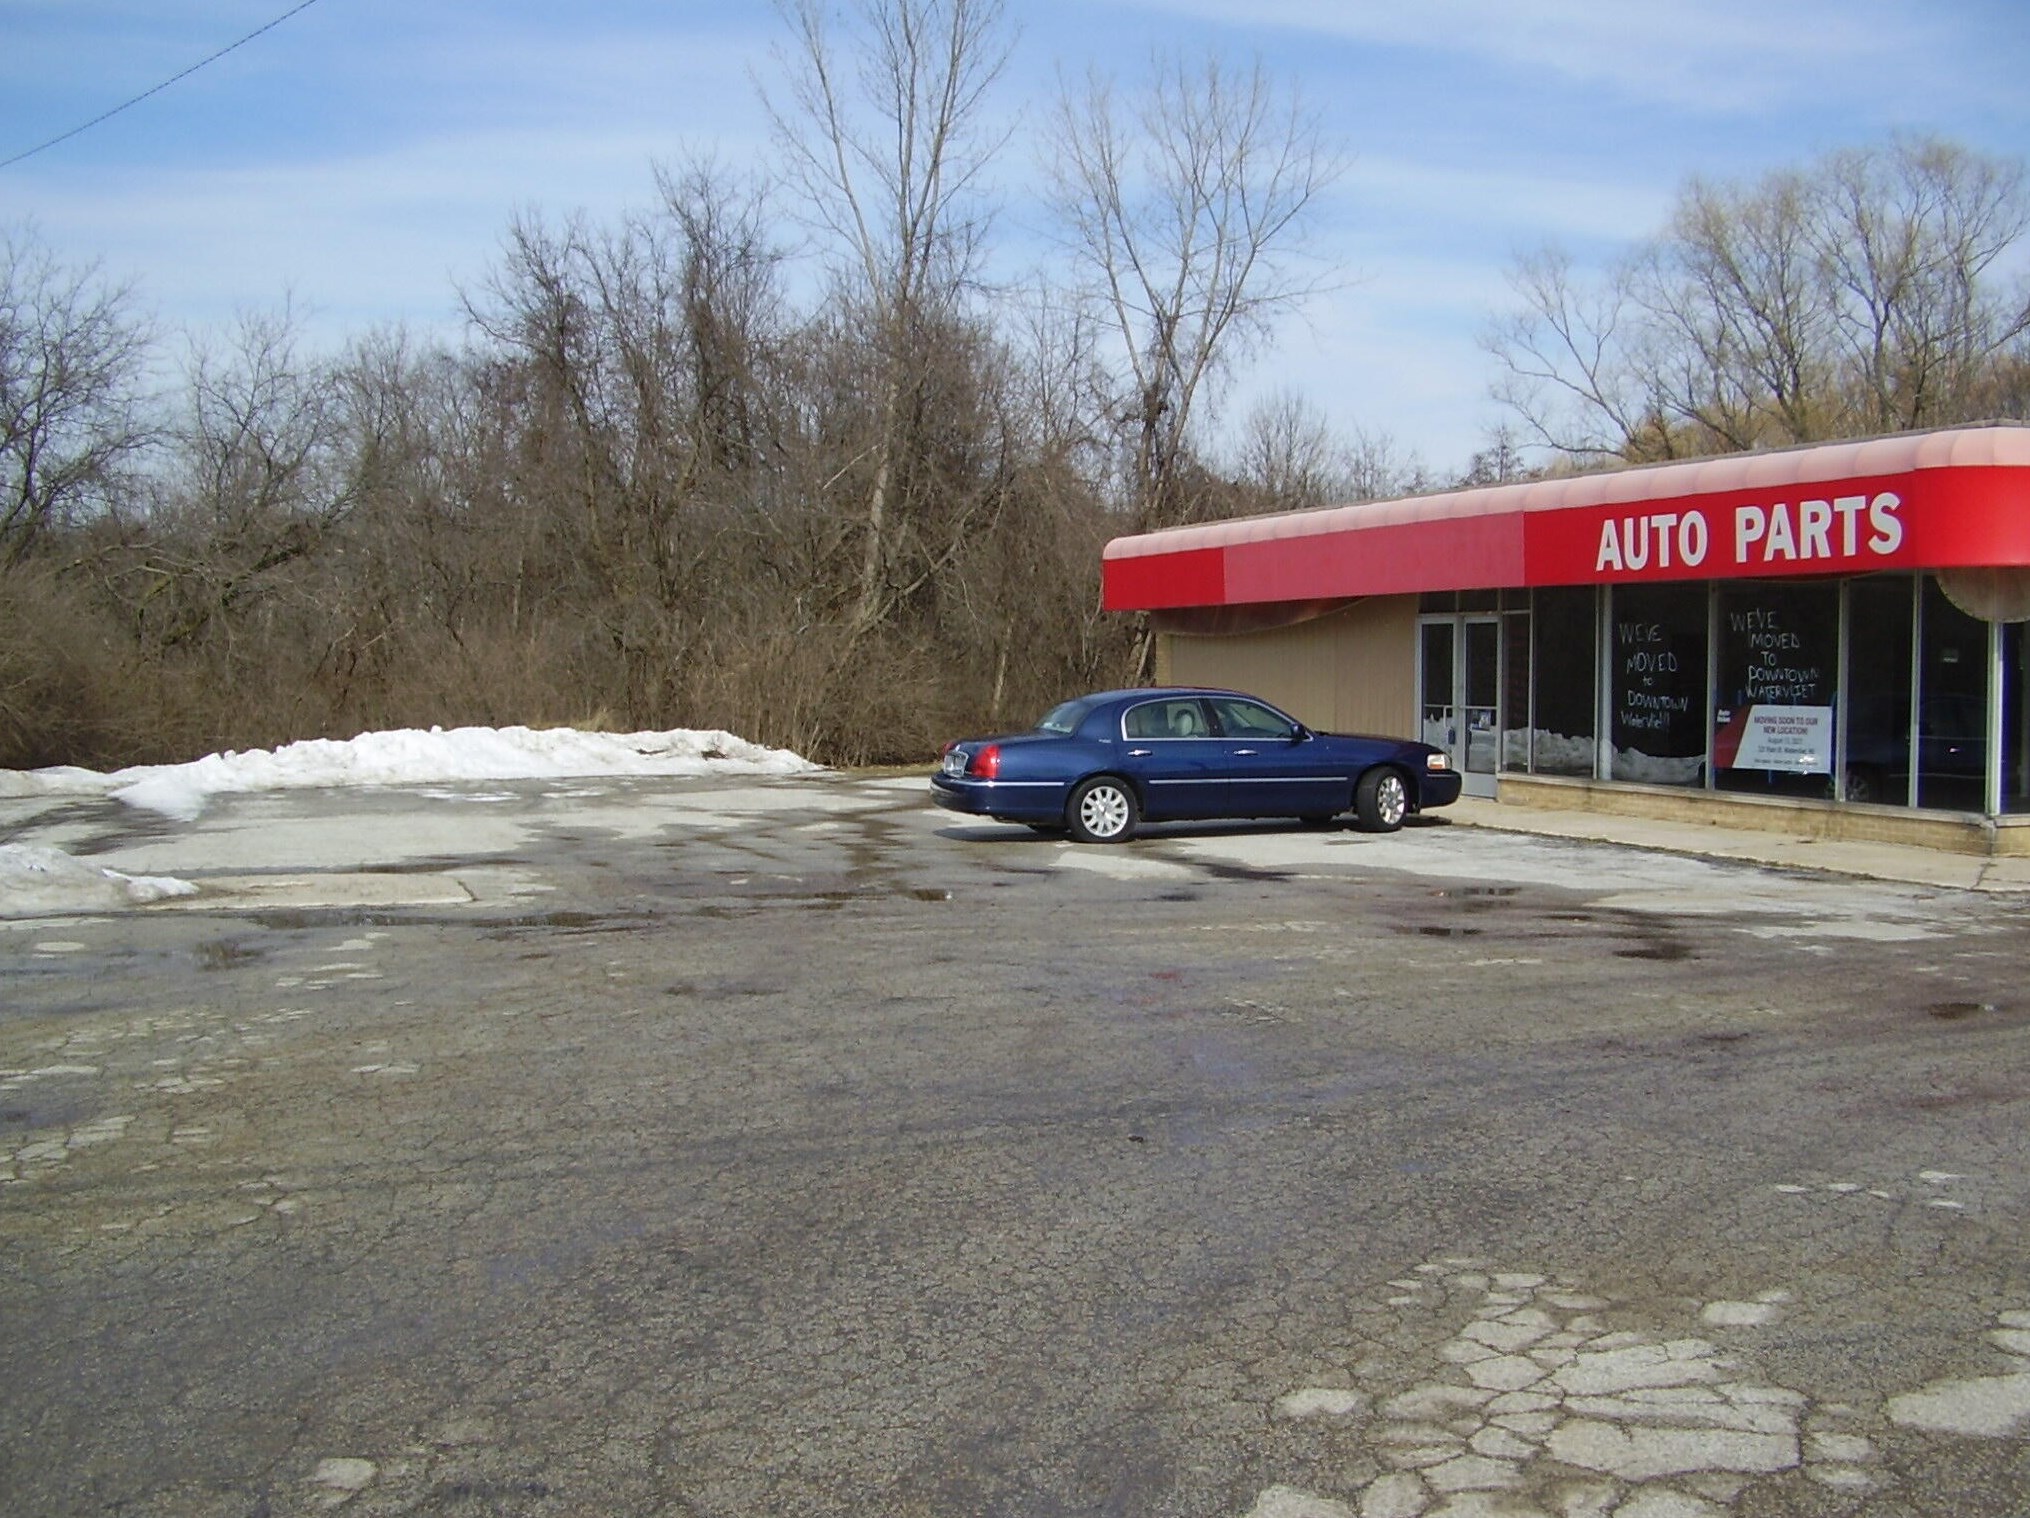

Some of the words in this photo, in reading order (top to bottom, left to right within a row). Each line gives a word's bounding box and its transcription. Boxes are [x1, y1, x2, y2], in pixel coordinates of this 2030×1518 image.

[1596, 510, 1707, 571] AUTO
[1735, 492, 1902, 563] PARTS
[1751, 632, 1800, 649] MOVED
[1626, 651, 1678, 674] MOVED
[1761, 651, 1777, 666] TO
